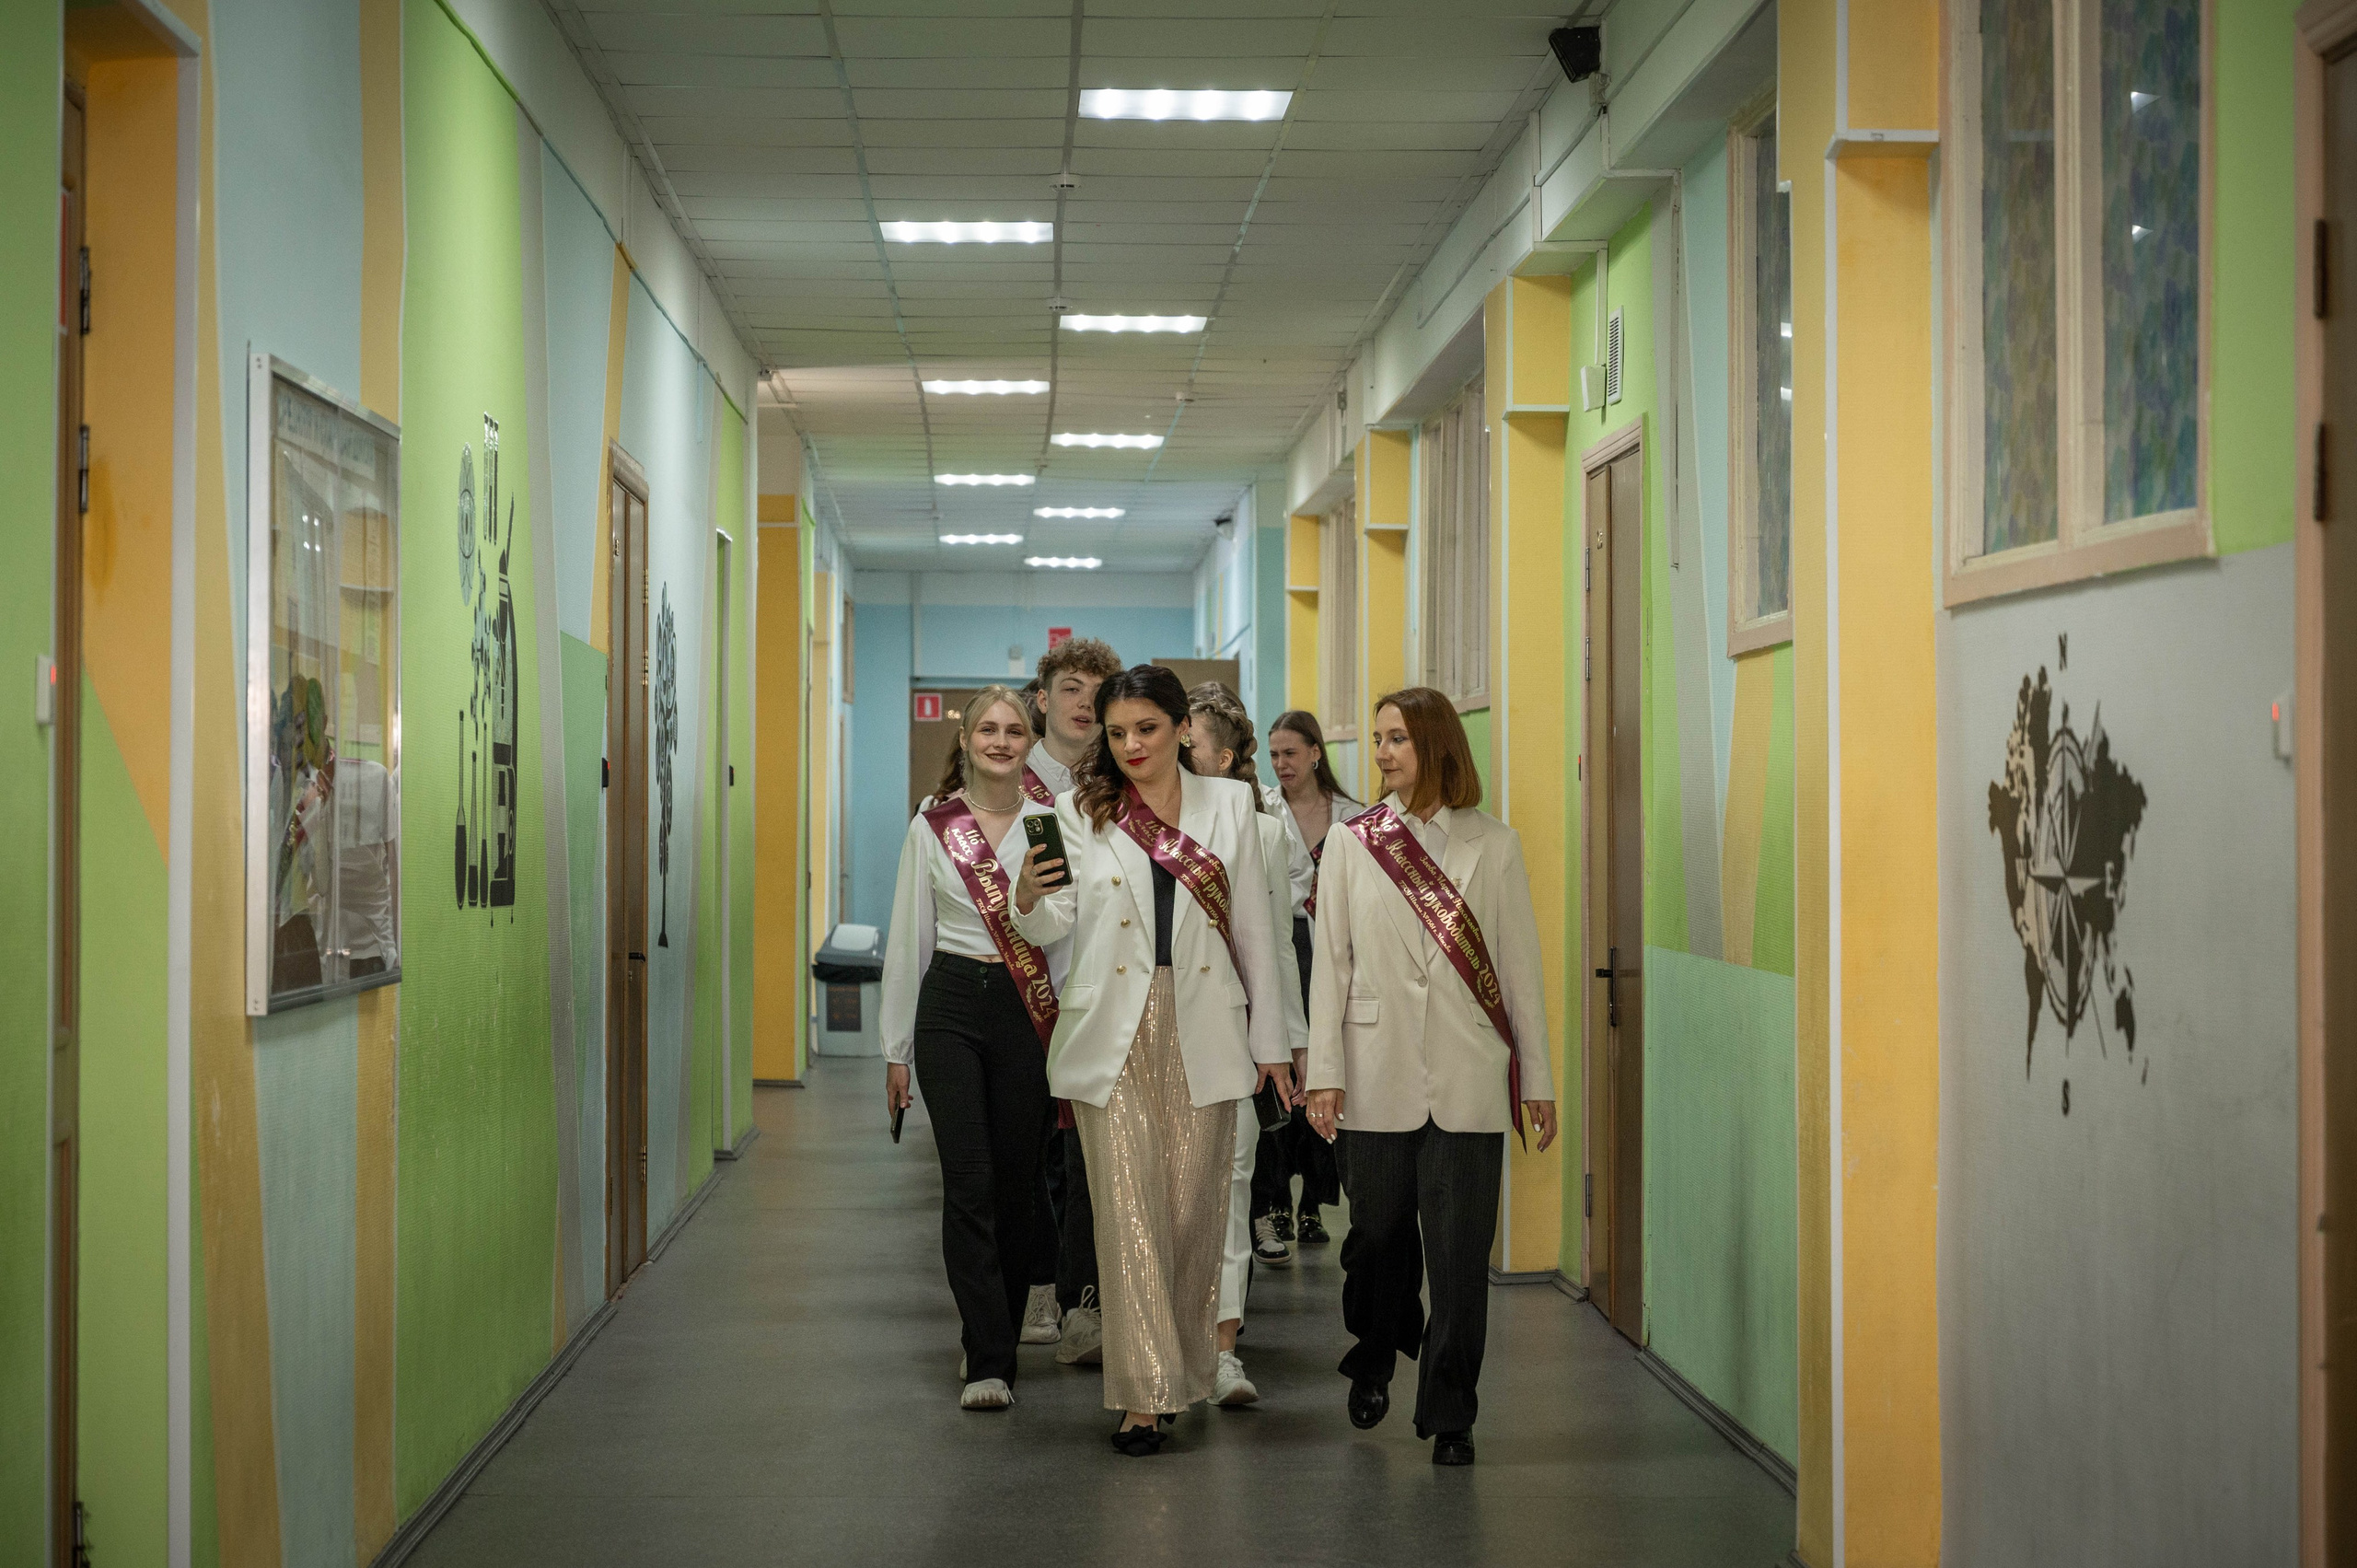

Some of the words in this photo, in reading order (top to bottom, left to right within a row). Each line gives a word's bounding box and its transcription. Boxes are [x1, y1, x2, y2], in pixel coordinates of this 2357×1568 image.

[951, 828, 973, 856] класс
[1158, 838, 1215, 885] Классный
[970, 858, 1038, 978] Выпускница
[1030, 973, 1058, 1019] 2024
[1386, 838, 1434, 894] Классный
[1419, 891, 1480, 970] руководитель
[1479, 963, 1501, 1005] 2024
[1453, 897, 1481, 943] Николаевна
